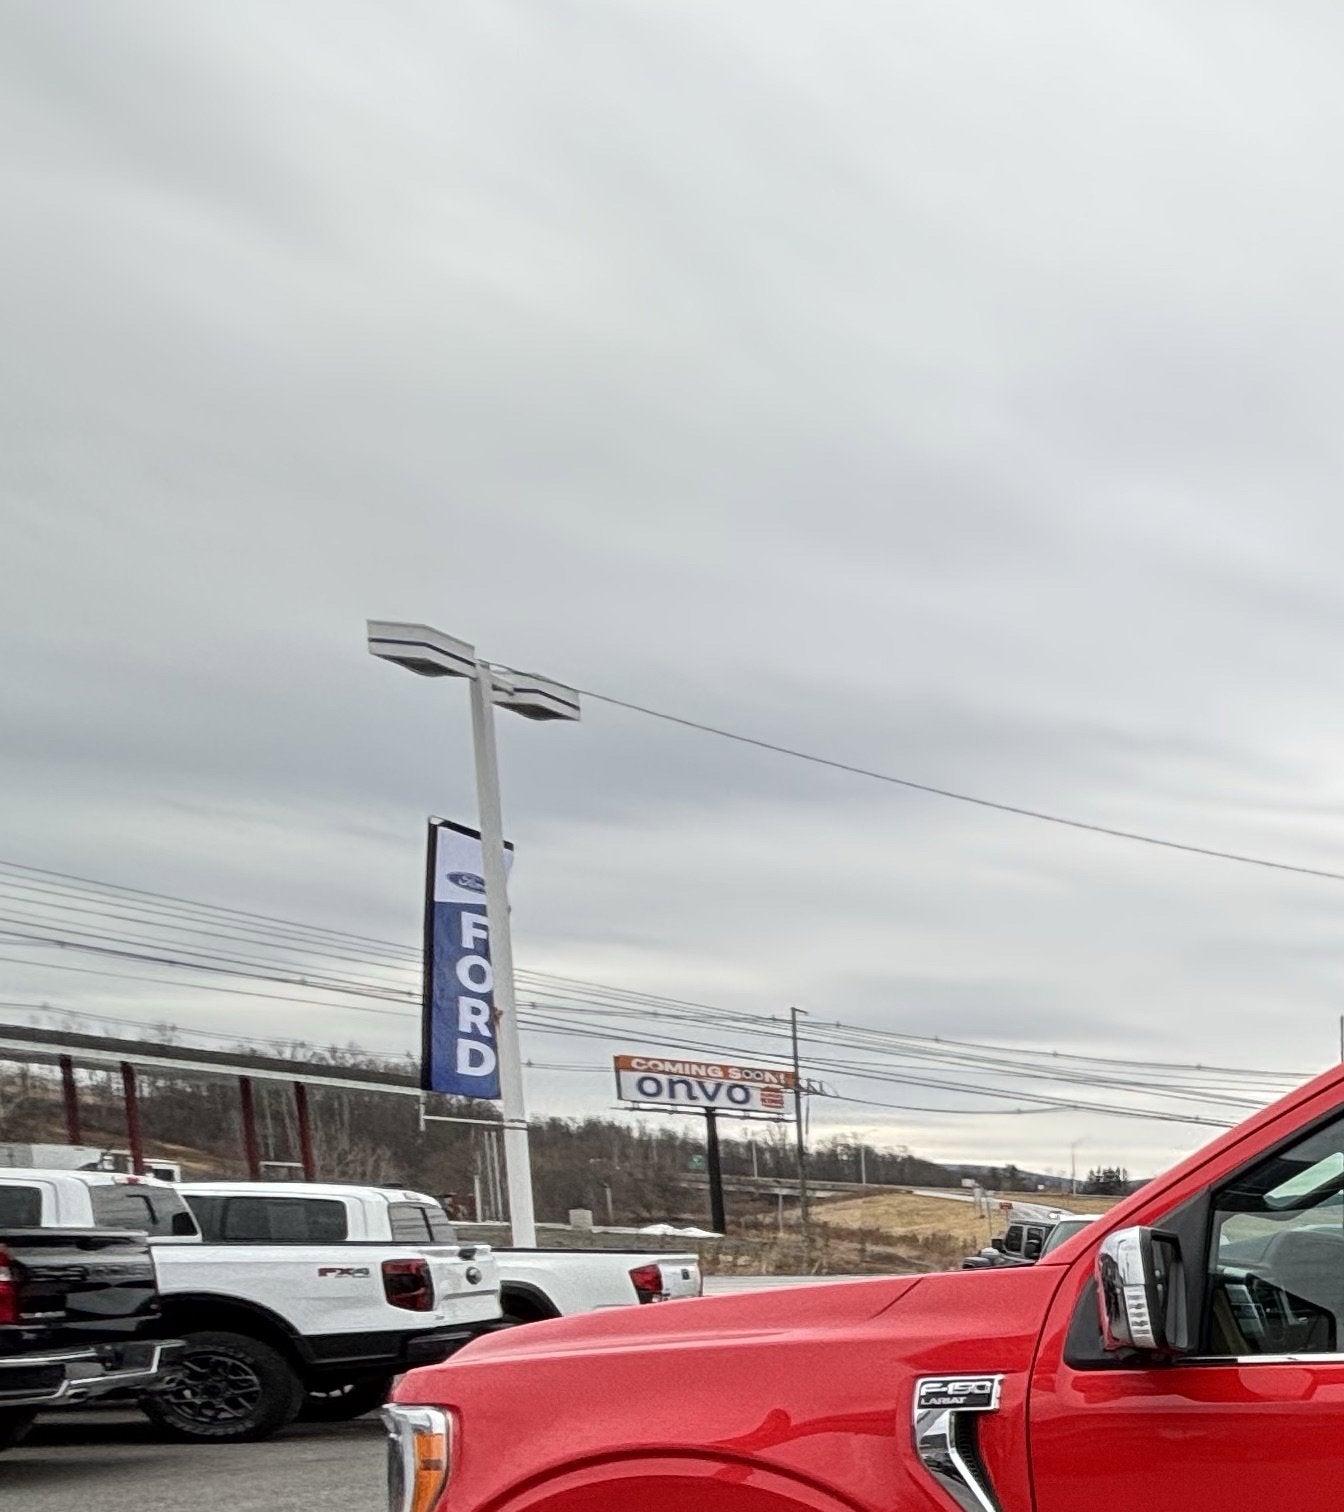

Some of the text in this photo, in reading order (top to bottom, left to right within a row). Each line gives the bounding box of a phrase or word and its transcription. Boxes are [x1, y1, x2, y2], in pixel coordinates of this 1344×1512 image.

[456, 911, 497, 1077] FORD
[630, 1057, 786, 1084] COMING SOON!
[637, 1075, 752, 1105] onvo
[920, 1381, 992, 1396] F-150
[920, 1396, 967, 1405] LARIAT
